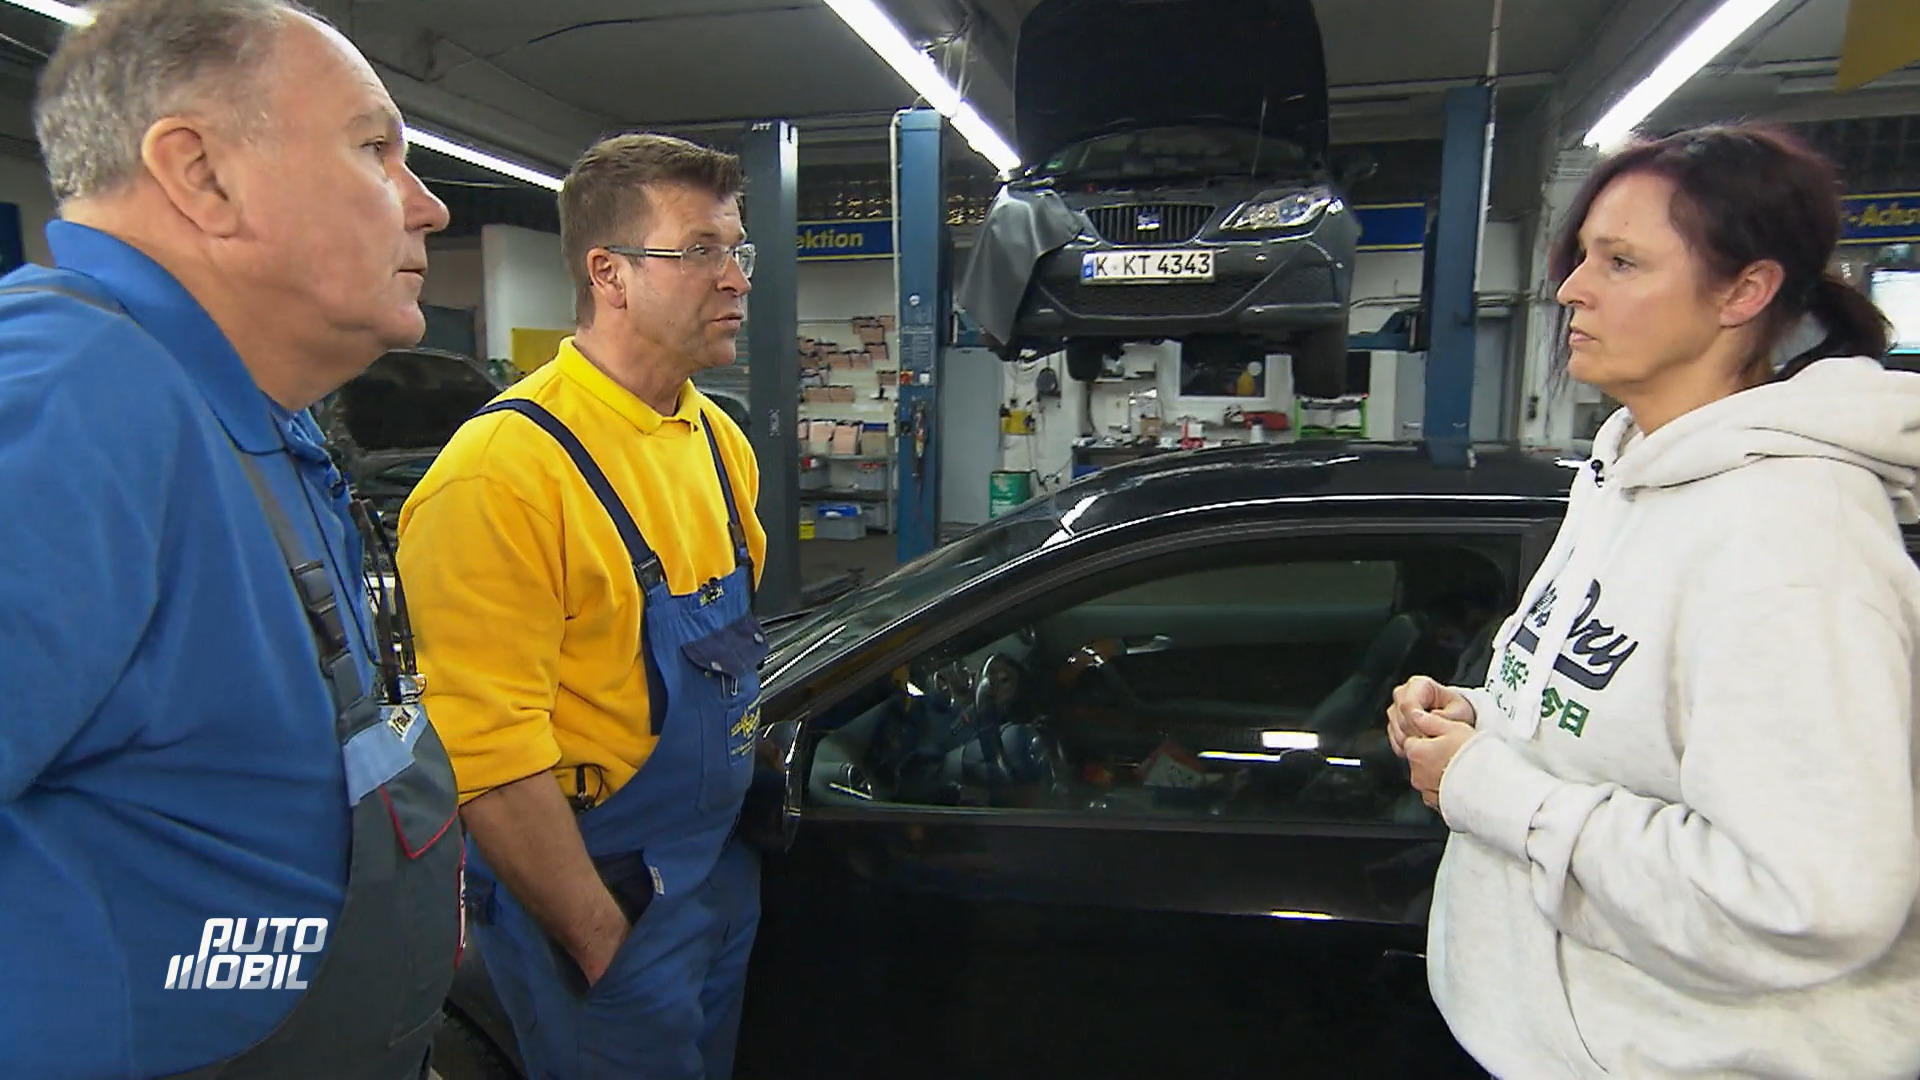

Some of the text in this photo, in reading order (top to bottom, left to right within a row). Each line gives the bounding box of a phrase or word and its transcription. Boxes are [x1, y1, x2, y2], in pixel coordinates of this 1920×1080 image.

[1095, 252, 1210, 276] K KT 4343
